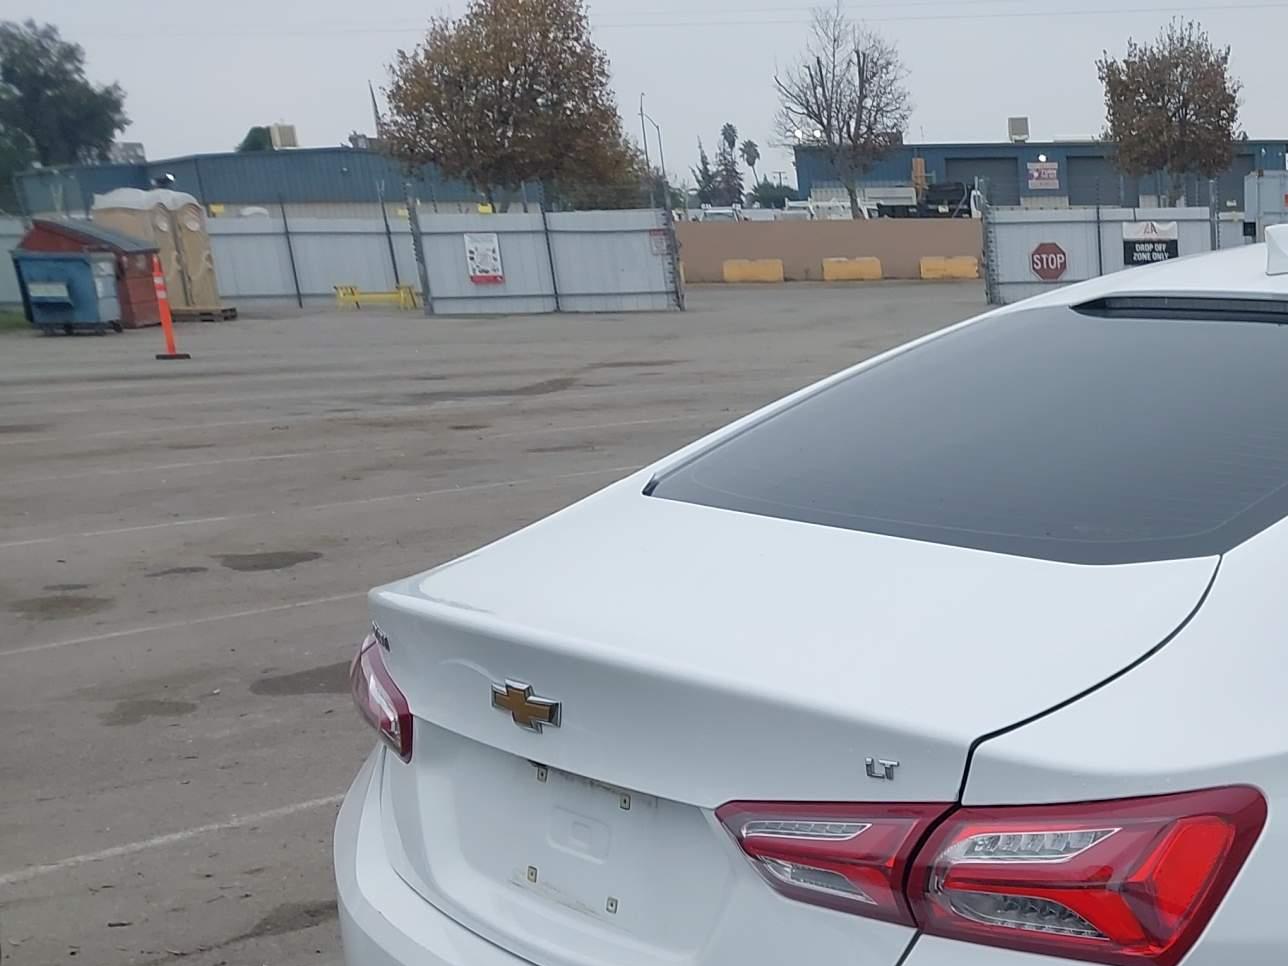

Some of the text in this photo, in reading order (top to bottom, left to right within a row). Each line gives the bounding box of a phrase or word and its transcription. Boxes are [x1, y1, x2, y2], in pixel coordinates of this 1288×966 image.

[1135, 243, 1154, 252] DROP
[1033, 253, 1065, 270] STOP
[1132, 251, 1169, 261] ZONE ONLY
[865, 757, 900, 781] LT
